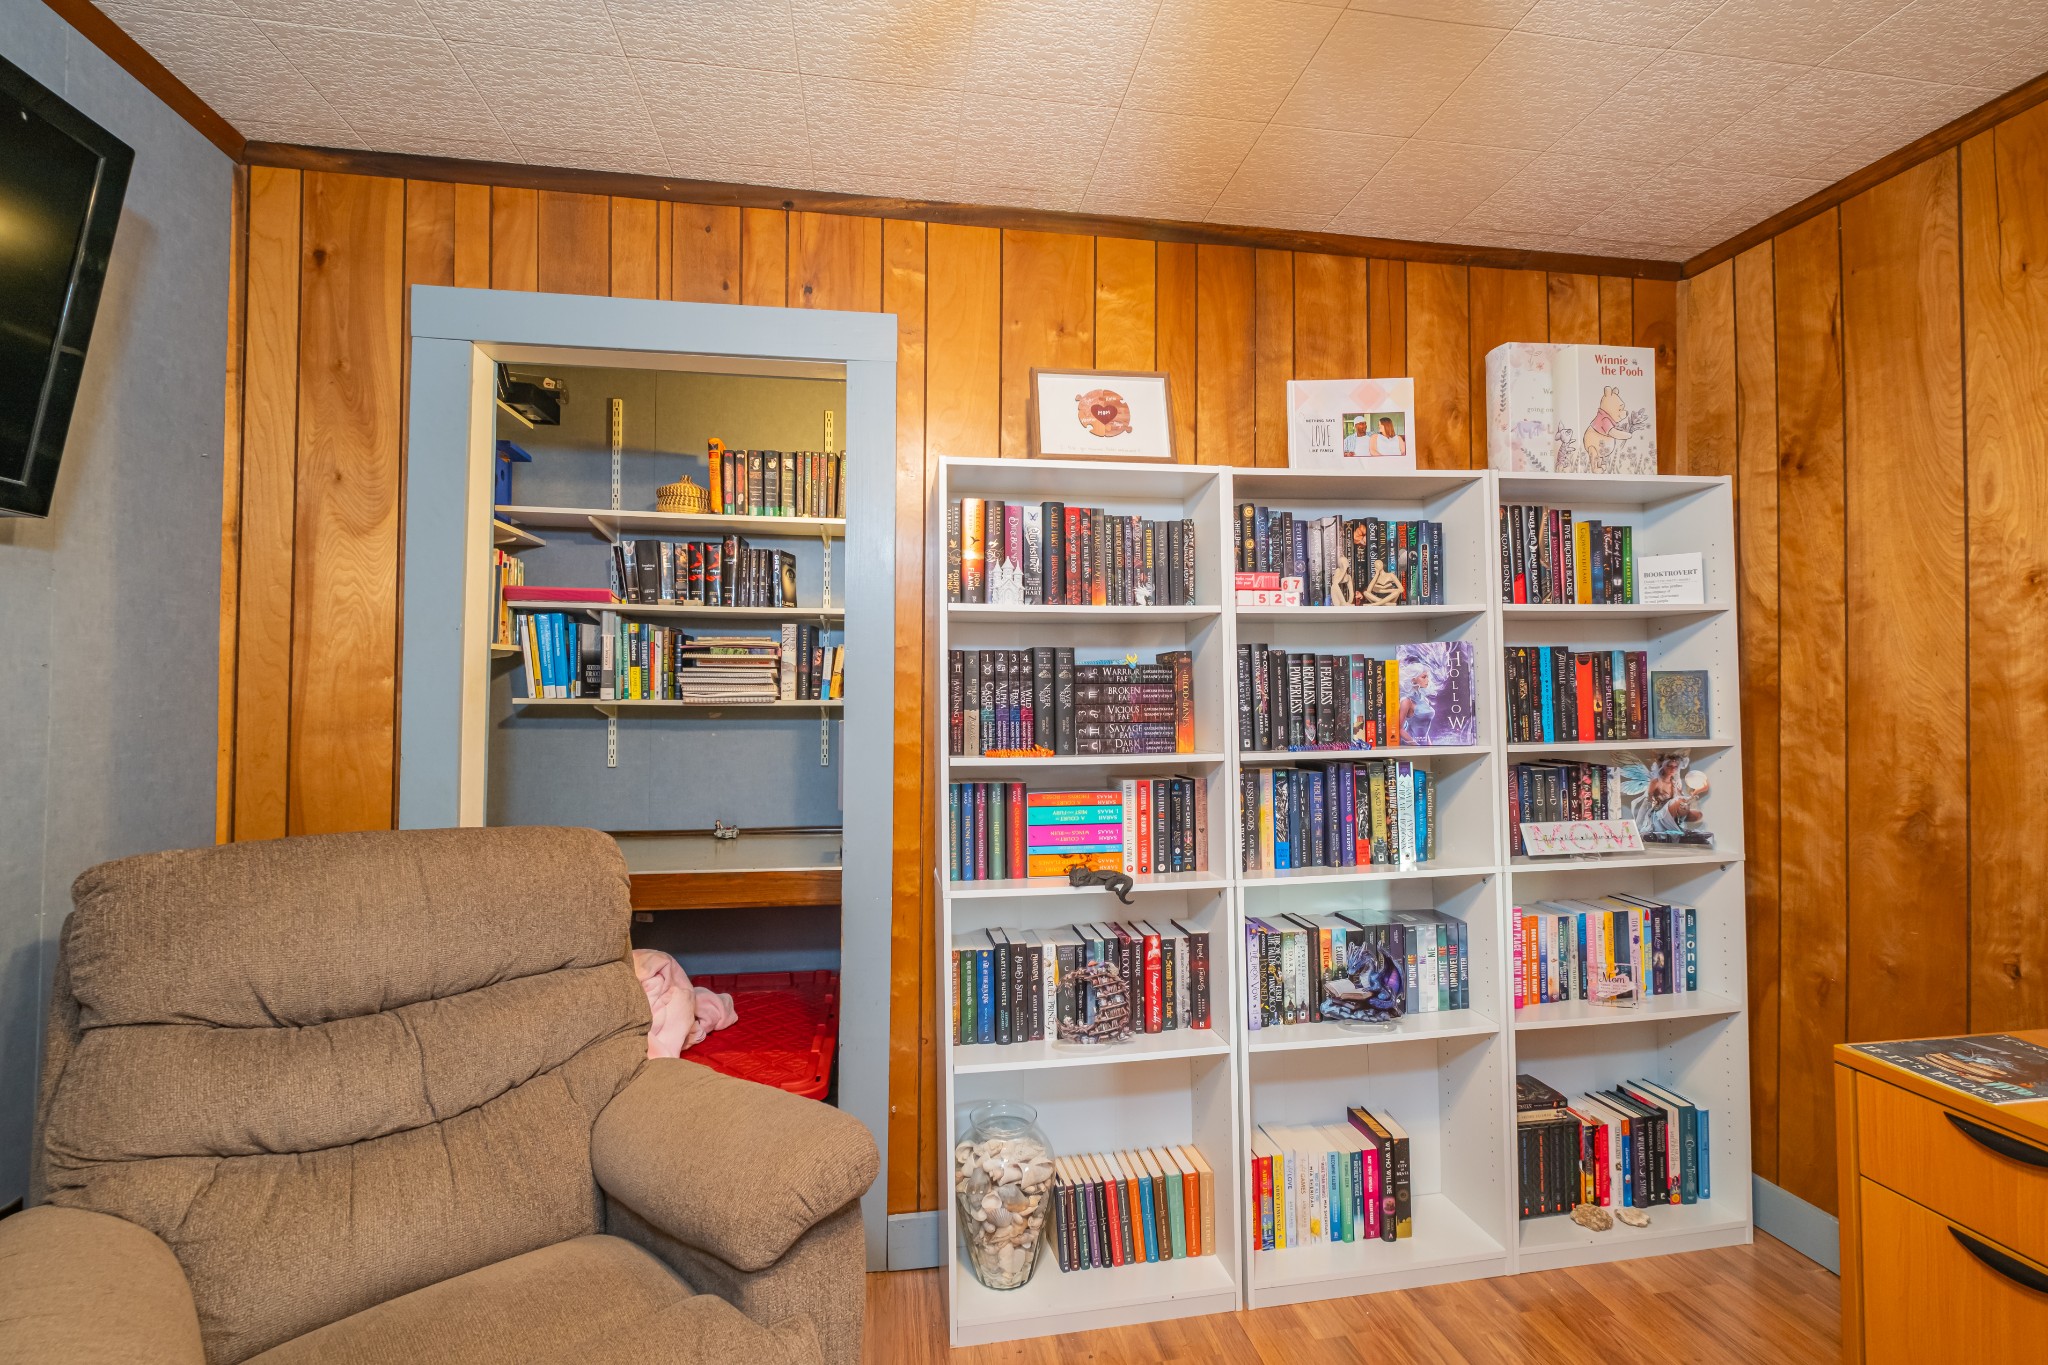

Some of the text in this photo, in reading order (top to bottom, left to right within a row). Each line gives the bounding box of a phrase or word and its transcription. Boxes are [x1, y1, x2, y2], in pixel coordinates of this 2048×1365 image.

[1594, 354, 1629, 366] Winnie
[1601, 366, 1644, 377] the Pooh
[1311, 424, 1332, 447] LOVE
[1398, 524, 1407, 549] BRIDE
[1408, 526, 1417, 547] MATE
[1501, 533, 1509, 557] ROAD
[1025, 526, 1042, 574] Quicksilver
[1564, 540, 1572, 568] BROKEN
[952, 569, 960, 594] FOURTH
[967, 567, 975, 591] FLAME
[1293, 580, 1300, 589] 7
[1565, 570, 1573, 596] BLADES
[1643, 568, 1698, 578] BOOKTROVERT
[1258, 593, 1266, 603] 5
[1274, 593, 1282, 603] 2
[984, 681, 994, 712] CAGED
[999, 682, 1008, 710] ALPHA
[1042, 683, 1052, 710] NEVER
[1063, 683, 1072, 710] NEVER
[1108, 686, 1141, 695] BROKEN
[1289, 666, 1303, 714] POWERLESS
[1302, 666, 1316, 705] RECKLESS
[1320, 666, 1333, 706] FEARLESS
[1448, 651, 1466, 731] HOLLOW
[952, 680, 960, 719] AWAKENING
[1012, 688, 1020, 709] FERAL
[1107, 705, 1140, 714] VICIOUS
[1605, 685, 1613, 721] SPELLSHOP
[1109, 724, 1142, 733] SAVAGE
[1115, 739, 1139, 748] DARK
[1246, 810, 1255, 832] GODS
[1529, 820, 1636, 853] MOM
[1121, 948, 1130, 978] BLOOD
[1323, 946, 1332, 969] FLOCK
[1334, 945, 1343, 969] EXODUS
[1427, 947, 1436, 958] ME
[1513, 911, 1522, 997] HAPPY PLACE EMILY HENRY
[1407, 954, 1417, 988] IMAGINE ME
[1438, 945, 1448, 985] IGNITE ME
[1449, 944, 1459, 988] UNRAVEL ME
[1460, 957, 1468, 981] SHATTER
[1250, 982, 1260, 1001] VOW
[1384, 1140, 1391, 1150] WE
[1385, 1152, 1393, 1169] WHO
[1385, 1169, 1393, 1184] WILL
